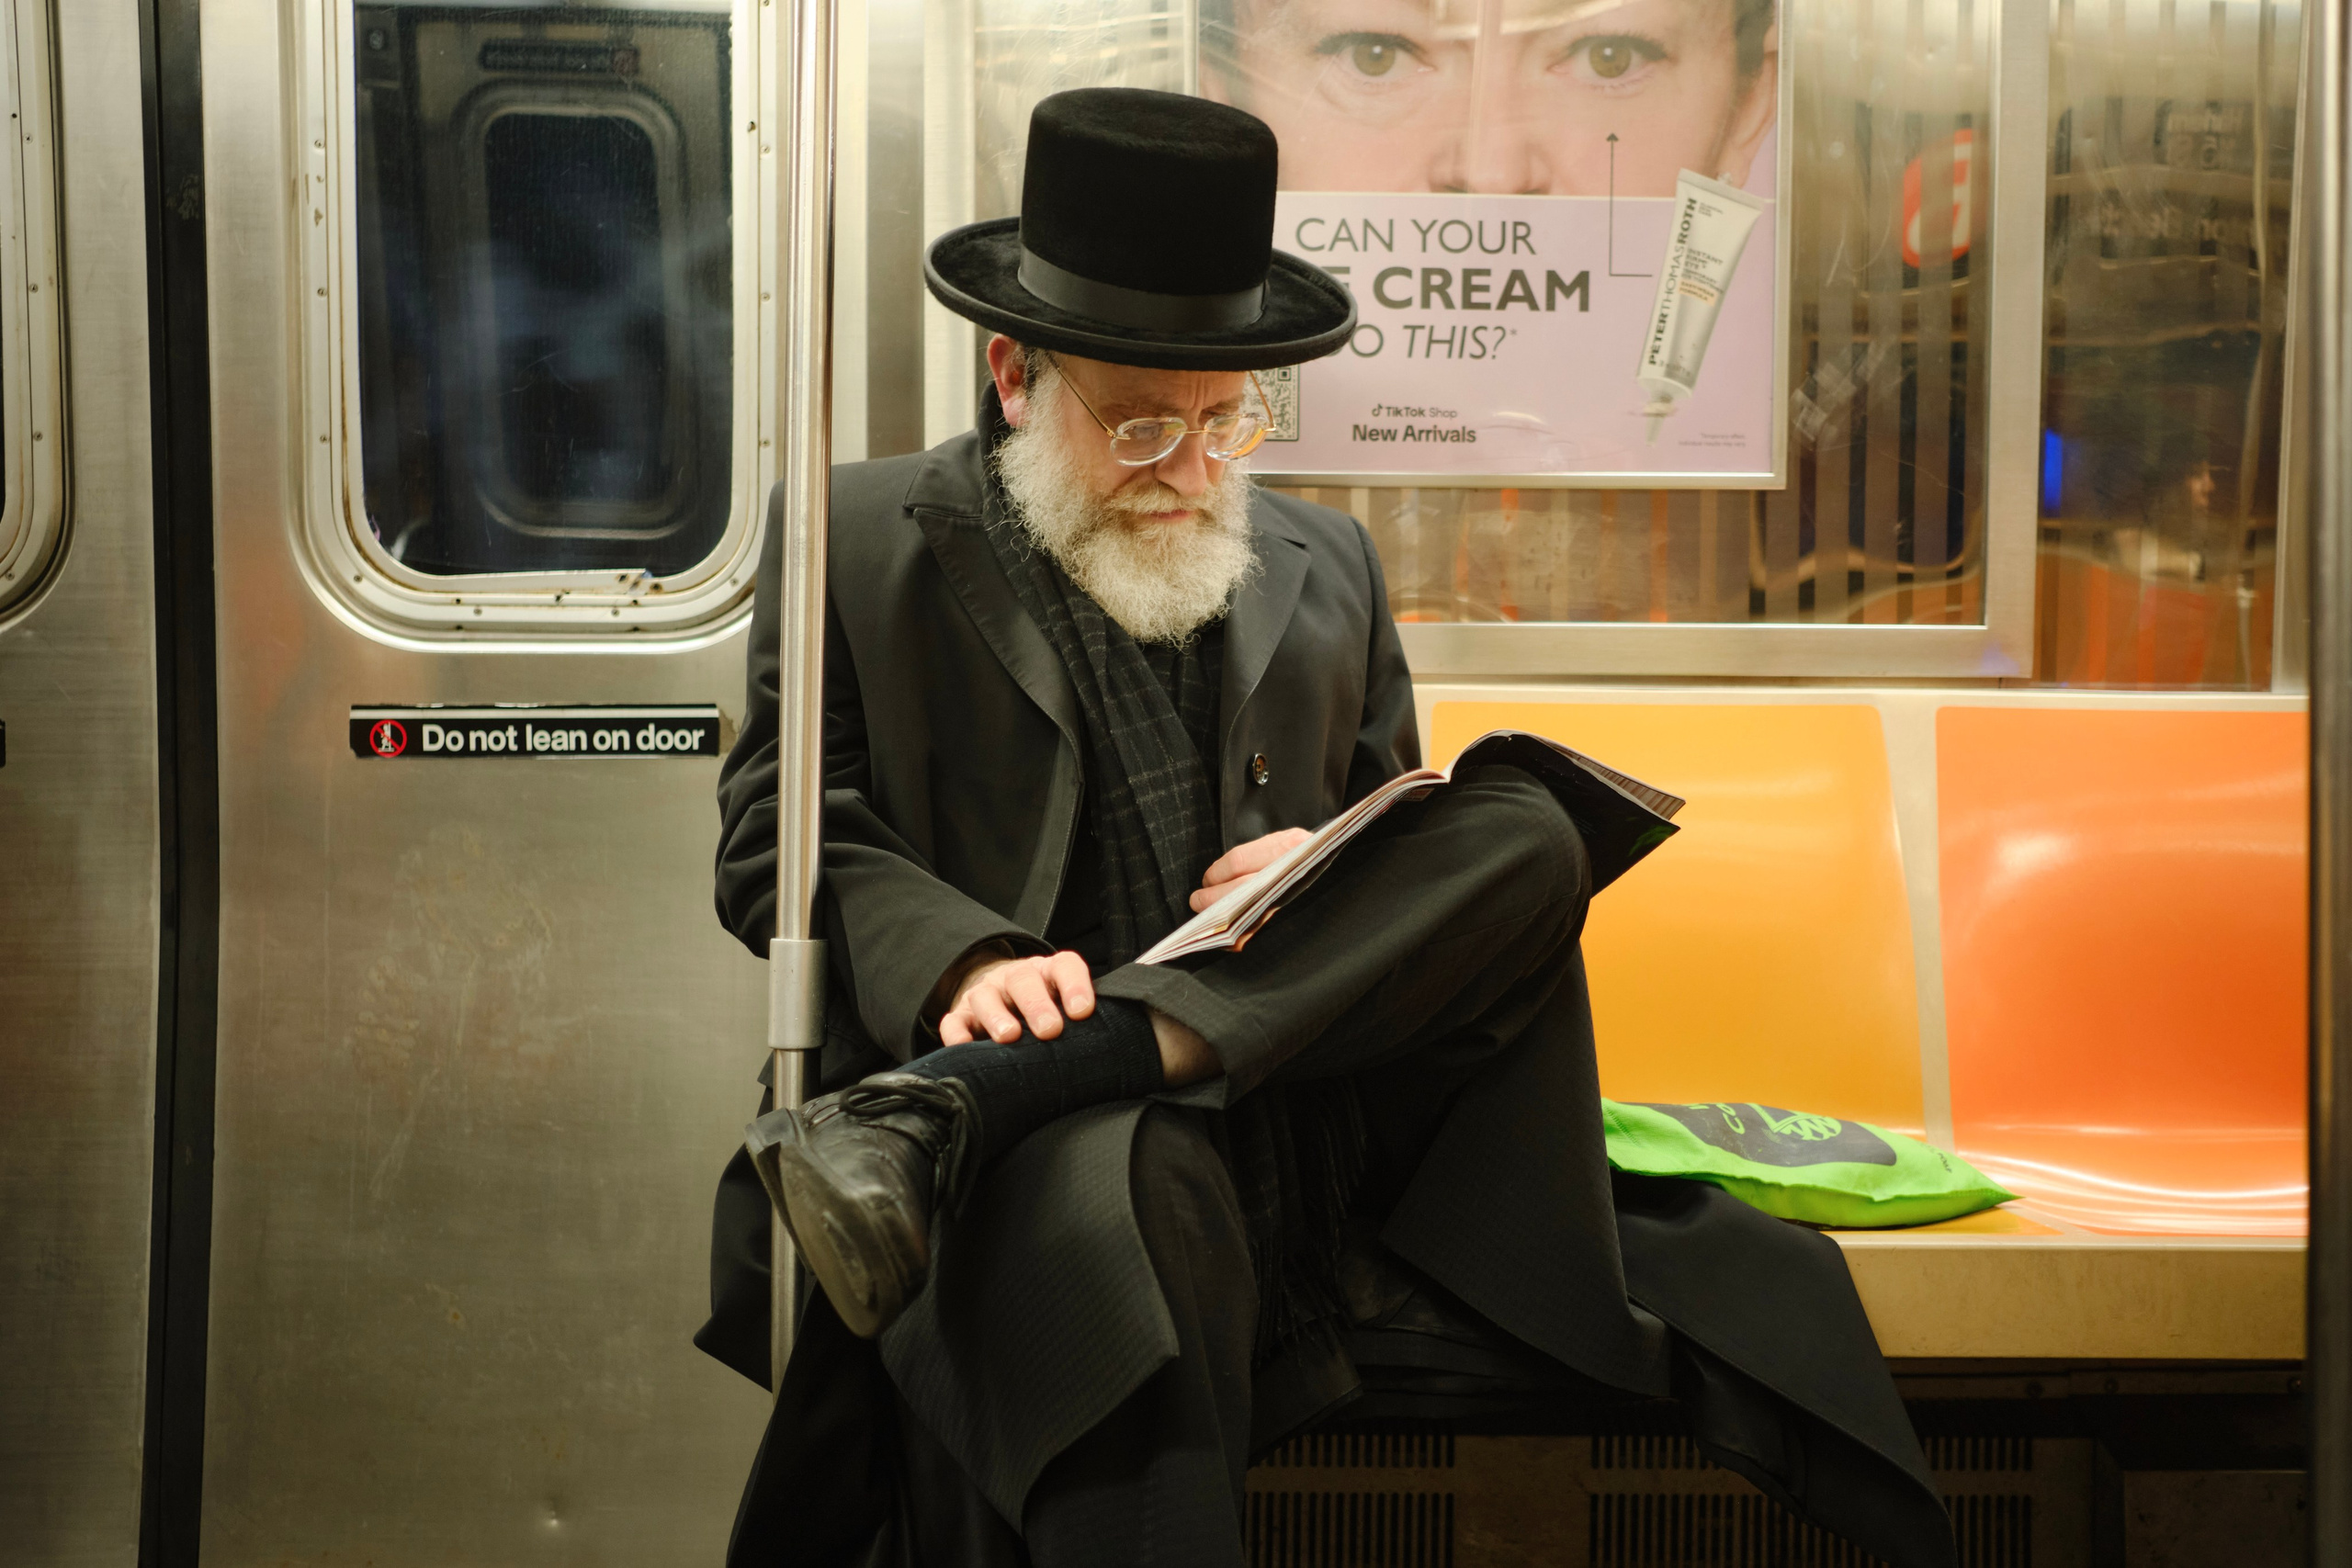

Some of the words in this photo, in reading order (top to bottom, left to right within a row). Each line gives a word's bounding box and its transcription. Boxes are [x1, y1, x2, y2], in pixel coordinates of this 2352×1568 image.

[1295, 218, 1394, 253] CAN
[1412, 220, 1537, 254] YOUR
[1373, 266, 1590, 312] CREAM
[1327, 323, 1385, 358] O
[1385, 406, 1426, 418] TikTok
[1429, 407, 1458, 420] Shop
[1352, 423, 1397, 442] New
[1402, 424, 1477, 444] Arrivals
[422, 724, 465, 752] Do
[469, 724, 517, 752] not
[526, 724, 588, 752] lean
[593, 730, 629, 752] on
[636, 724, 706, 752] door
